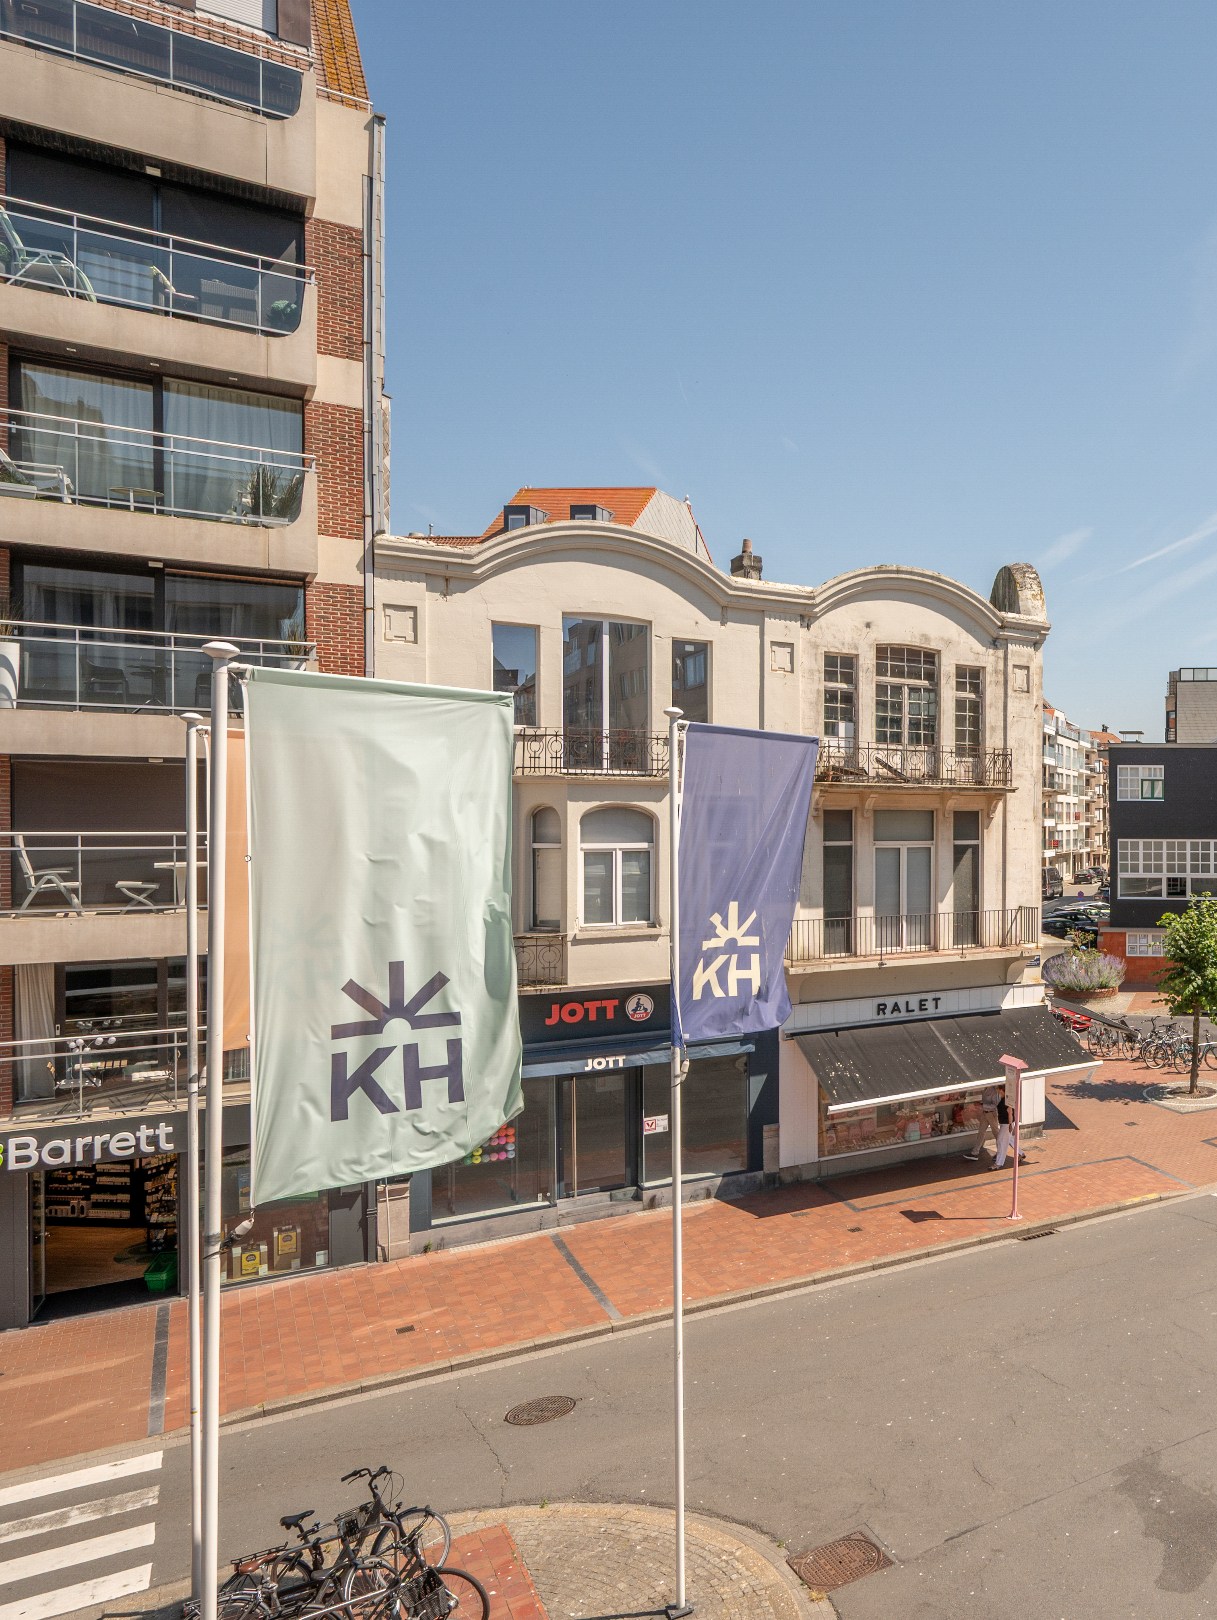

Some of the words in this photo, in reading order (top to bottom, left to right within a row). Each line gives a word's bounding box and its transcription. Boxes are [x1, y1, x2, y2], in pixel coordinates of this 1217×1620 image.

[692, 953, 760, 1000] KH
[545, 999, 619, 1025] JOTT
[876, 997, 941, 1016] RALET
[330, 1038, 464, 1122] KH
[584, 1055, 626, 1071] JOTT
[8, 1122, 175, 1170] Barrett
